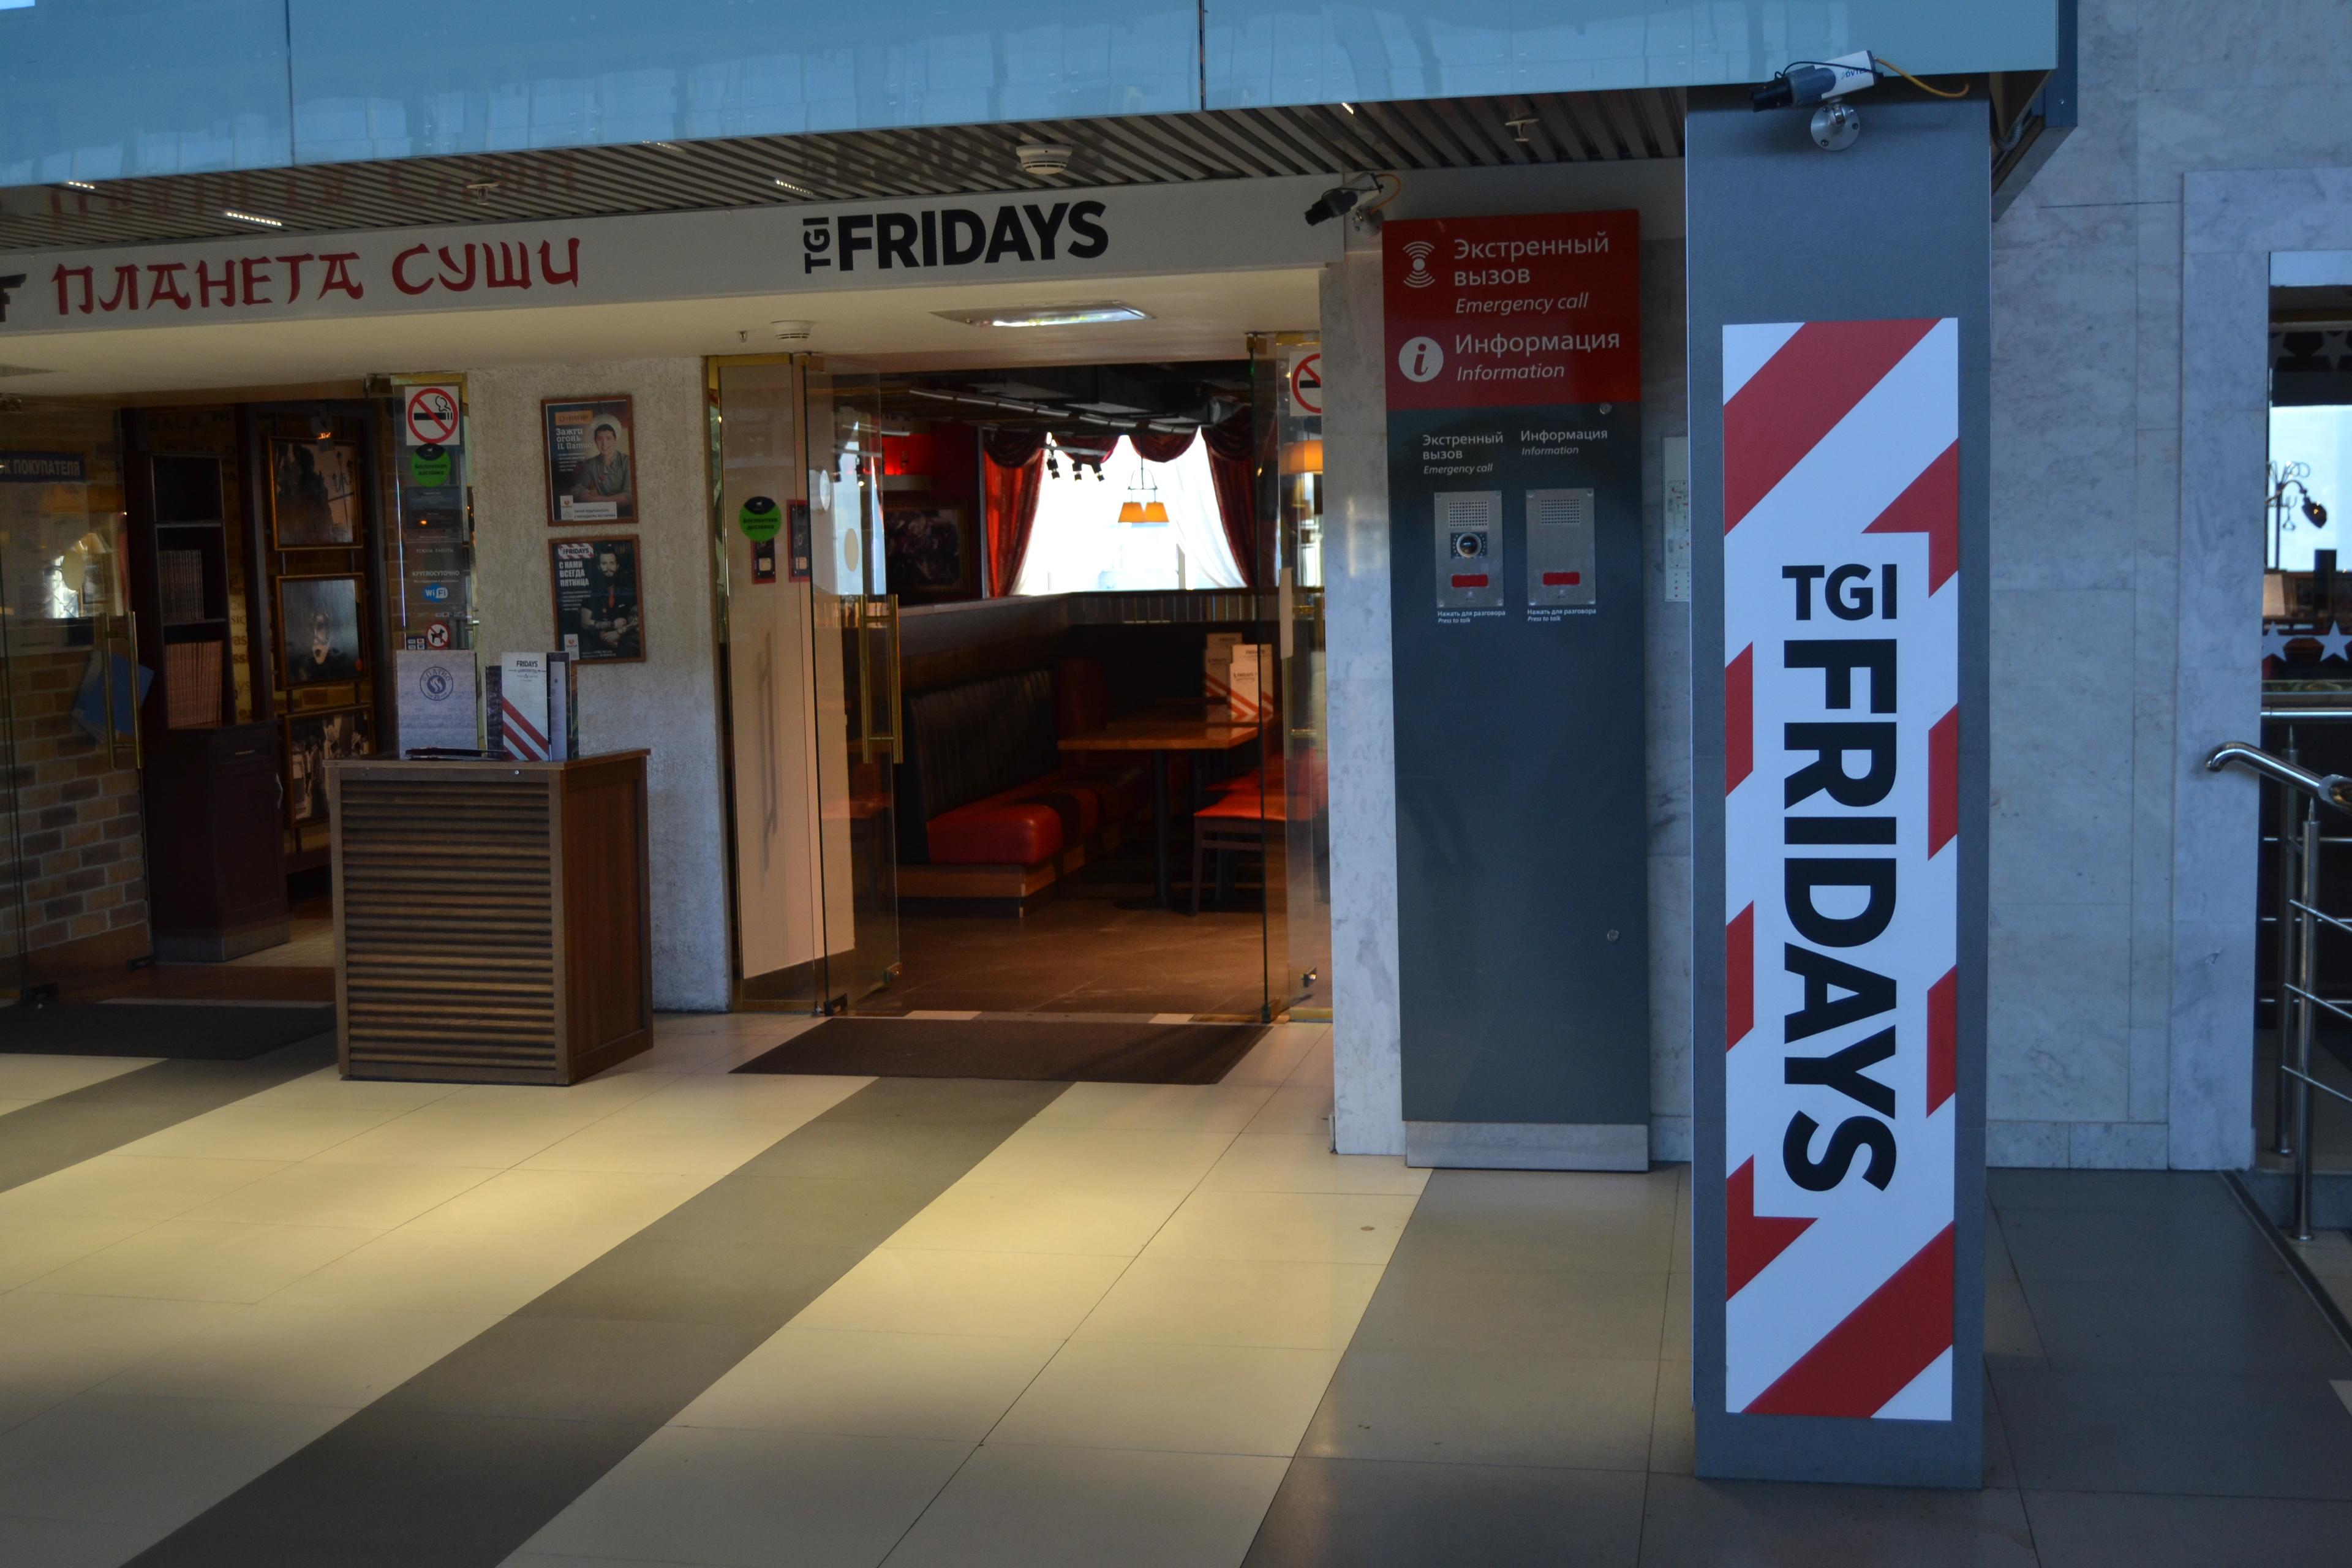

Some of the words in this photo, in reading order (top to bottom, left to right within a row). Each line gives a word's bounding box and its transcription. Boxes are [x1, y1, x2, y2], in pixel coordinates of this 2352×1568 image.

[803, 217, 831, 274] TGI
[837, 200, 1109, 271] FRIDAYS
[1454, 232, 1609, 262] Экстренный
[51, 252, 364, 316] ПЛАНЕТА
[391, 237, 581, 296] СУШИ
[1454, 268, 1531, 287] вызов
[1456, 296, 1553, 315] Emergency
[1558, 292, 1589, 309] call
[1456, 333, 1621, 358] Информация
[1457, 363, 1565, 382] Information
[1423, 431, 1503, 448] Экстренный
[1520, 430, 1608, 443] Информация
[1423, 450, 1463, 460] вызов
[1522, 446, 1579, 456] Information
[13, 459, 80, 476] ПОКУПАТЕЛЯ
[1423, 465, 1475, 475] Emergency
[1477, 464, 1493, 472] call
[559, 569, 586, 578] ВСЕГДА
[560, 578, 589, 587] ПЯТНИЦА
[1781, 563, 1898, 621] TGI
[1782, 638, 1898, 1192] FRIDAYS
